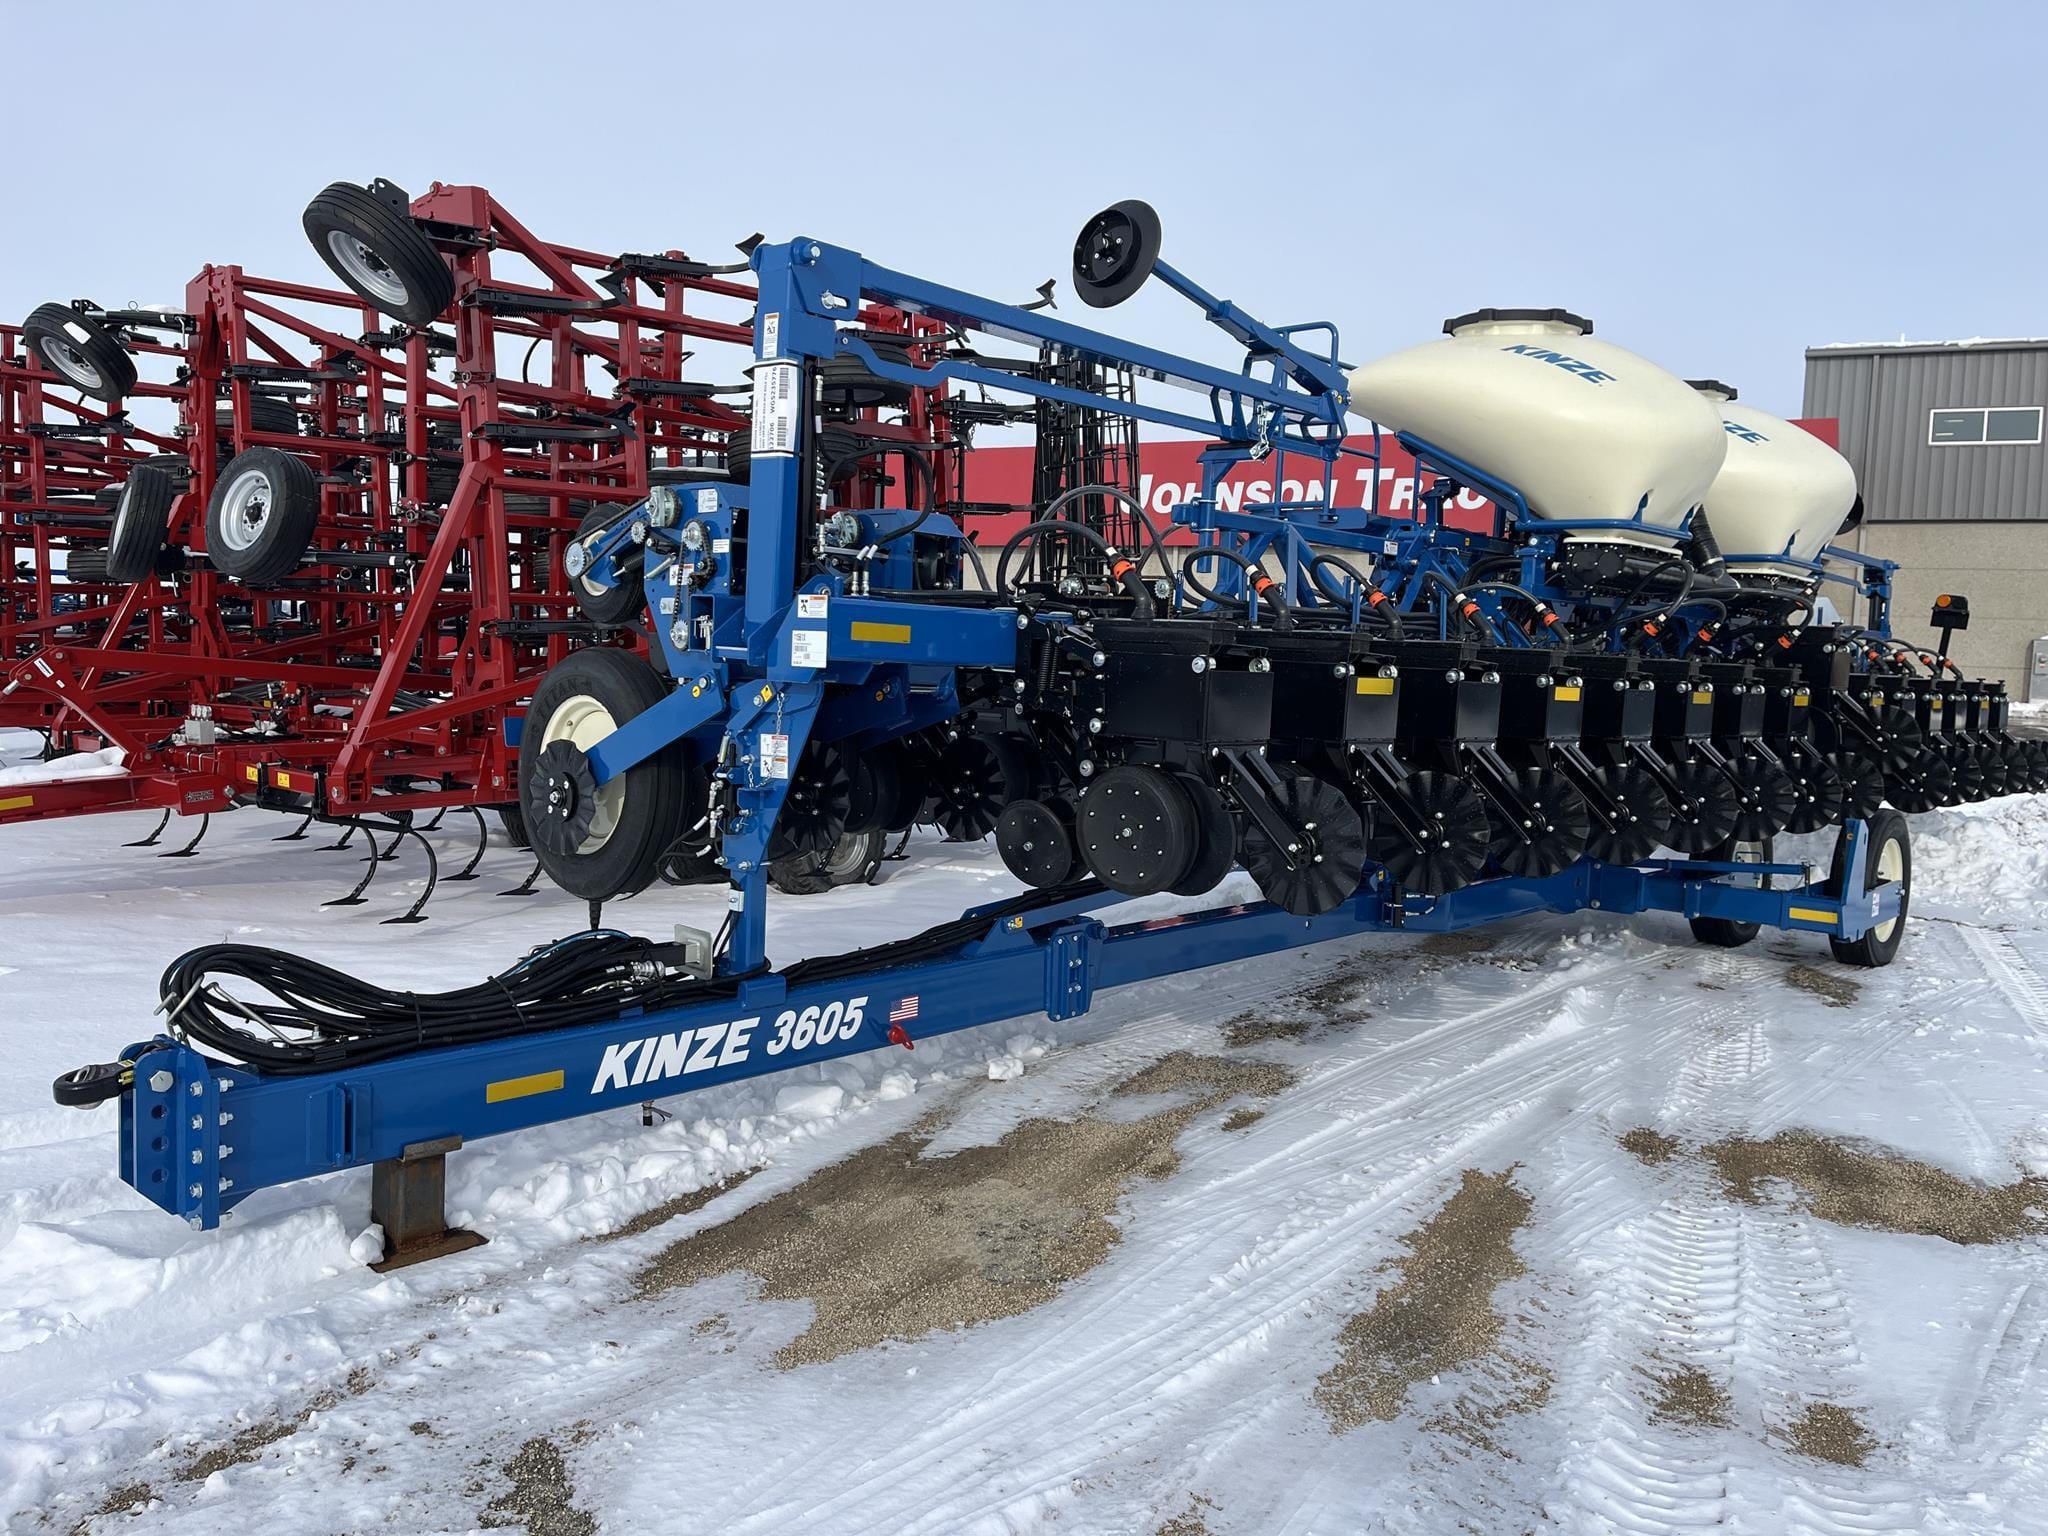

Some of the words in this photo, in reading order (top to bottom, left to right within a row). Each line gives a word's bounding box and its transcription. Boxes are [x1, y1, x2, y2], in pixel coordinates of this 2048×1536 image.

[1500, 344, 1617, 384] KINZE
[1355, 468, 1488, 510] TRC
[590, 1016, 760, 1095] KINZE
[767, 995, 869, 1056] 3605
